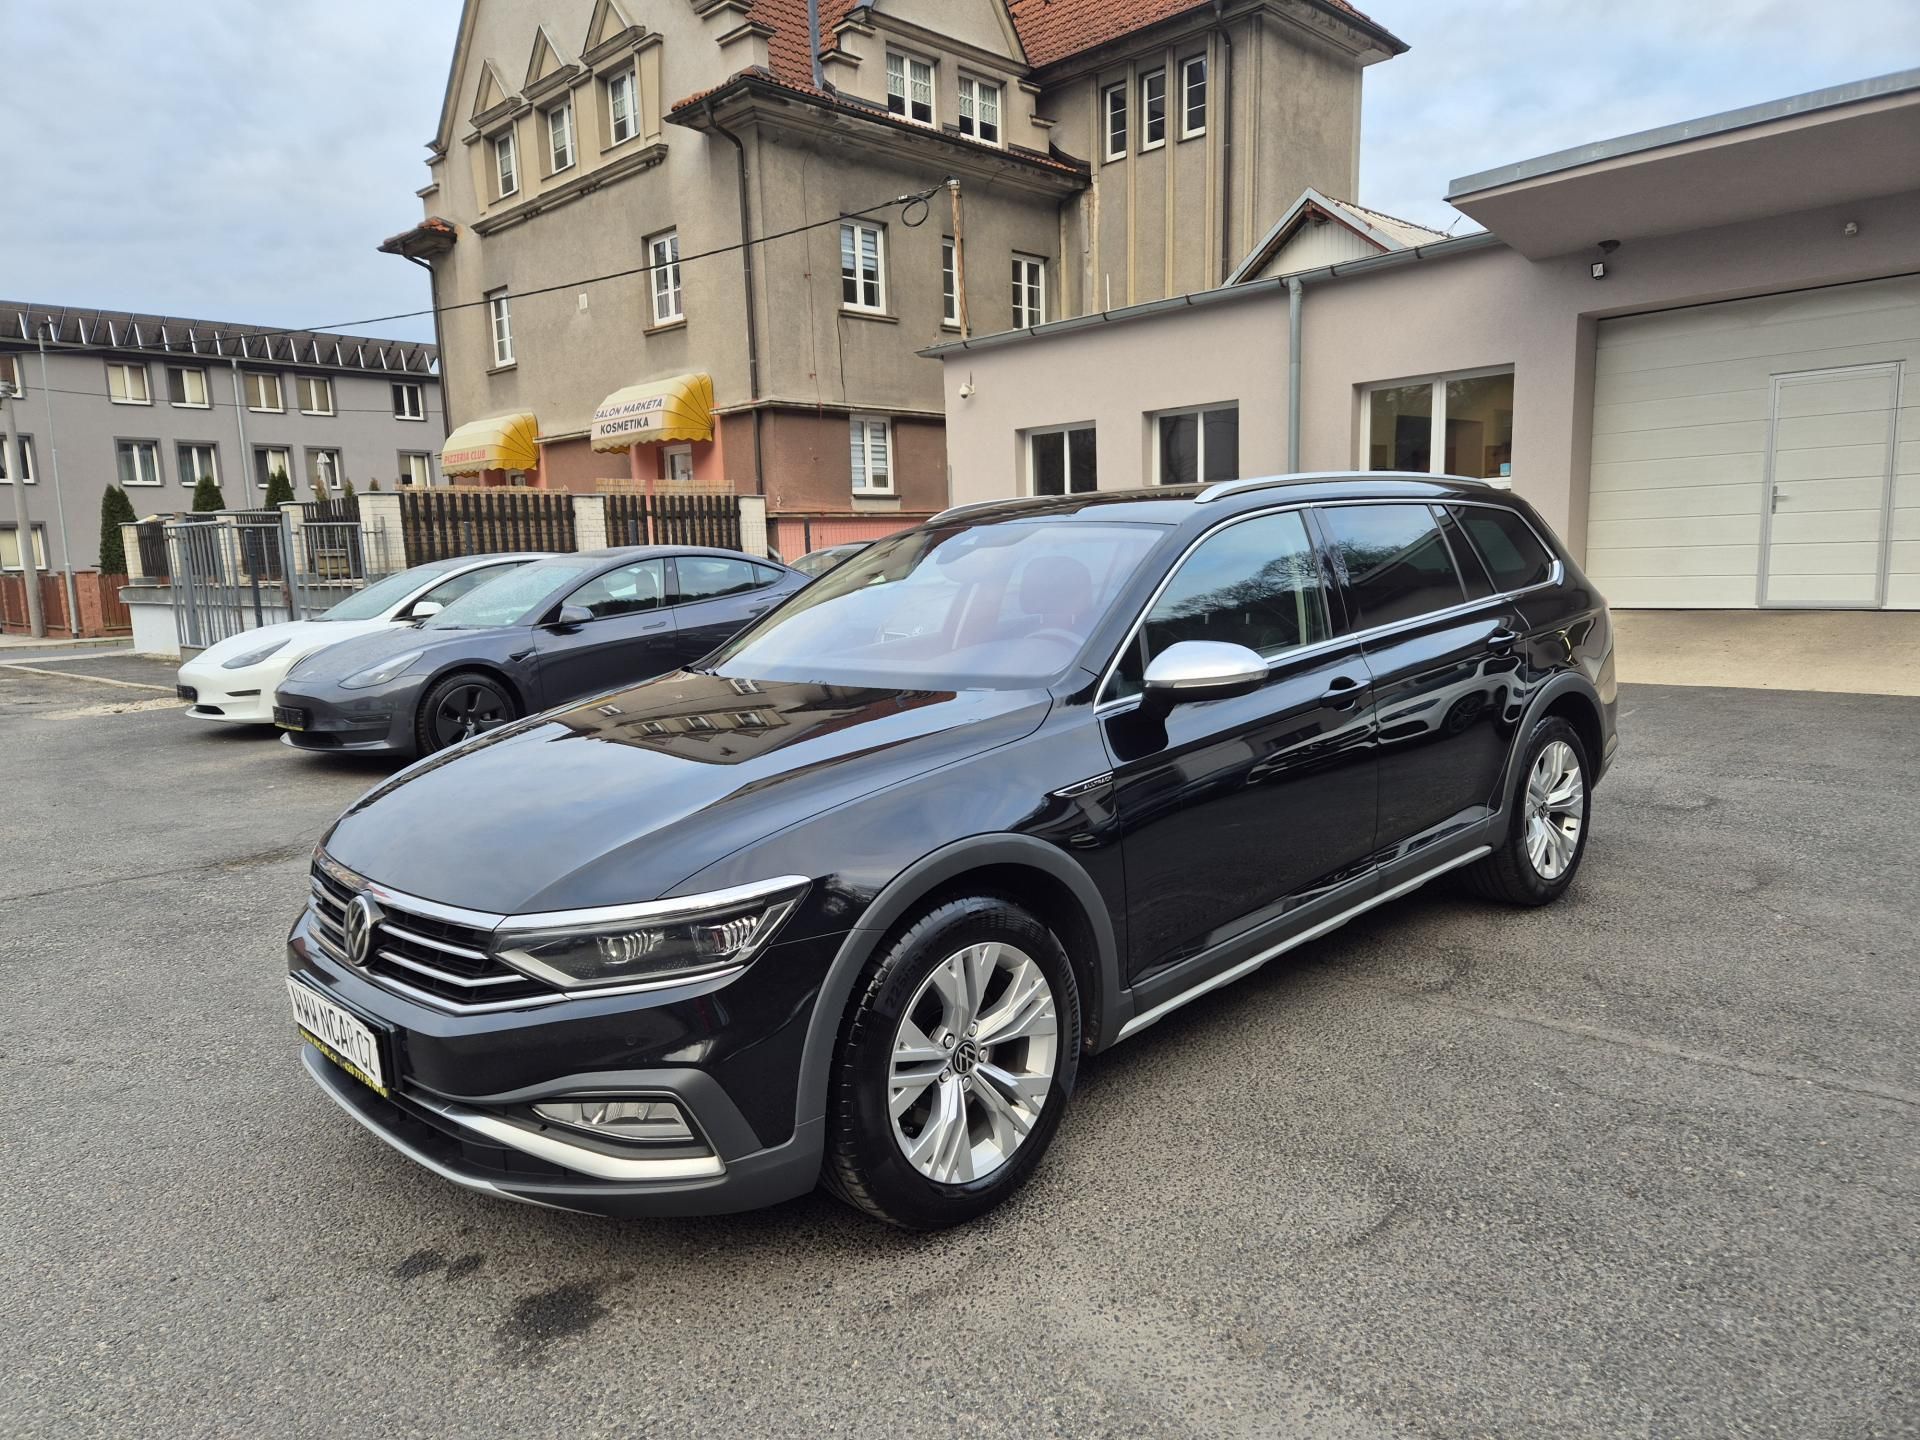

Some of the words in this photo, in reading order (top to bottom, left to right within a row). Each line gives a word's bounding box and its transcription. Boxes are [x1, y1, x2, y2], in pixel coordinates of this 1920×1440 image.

[595, 406, 622, 420] SALON
[623, 398, 663, 414] MARKETA
[600, 416, 649, 436] KOSMETIKA
[444, 451, 470, 465] PIZZERIA
[470, 449, 486, 460] CLUB
[1083, 775, 1112, 790] ALLTRACK
